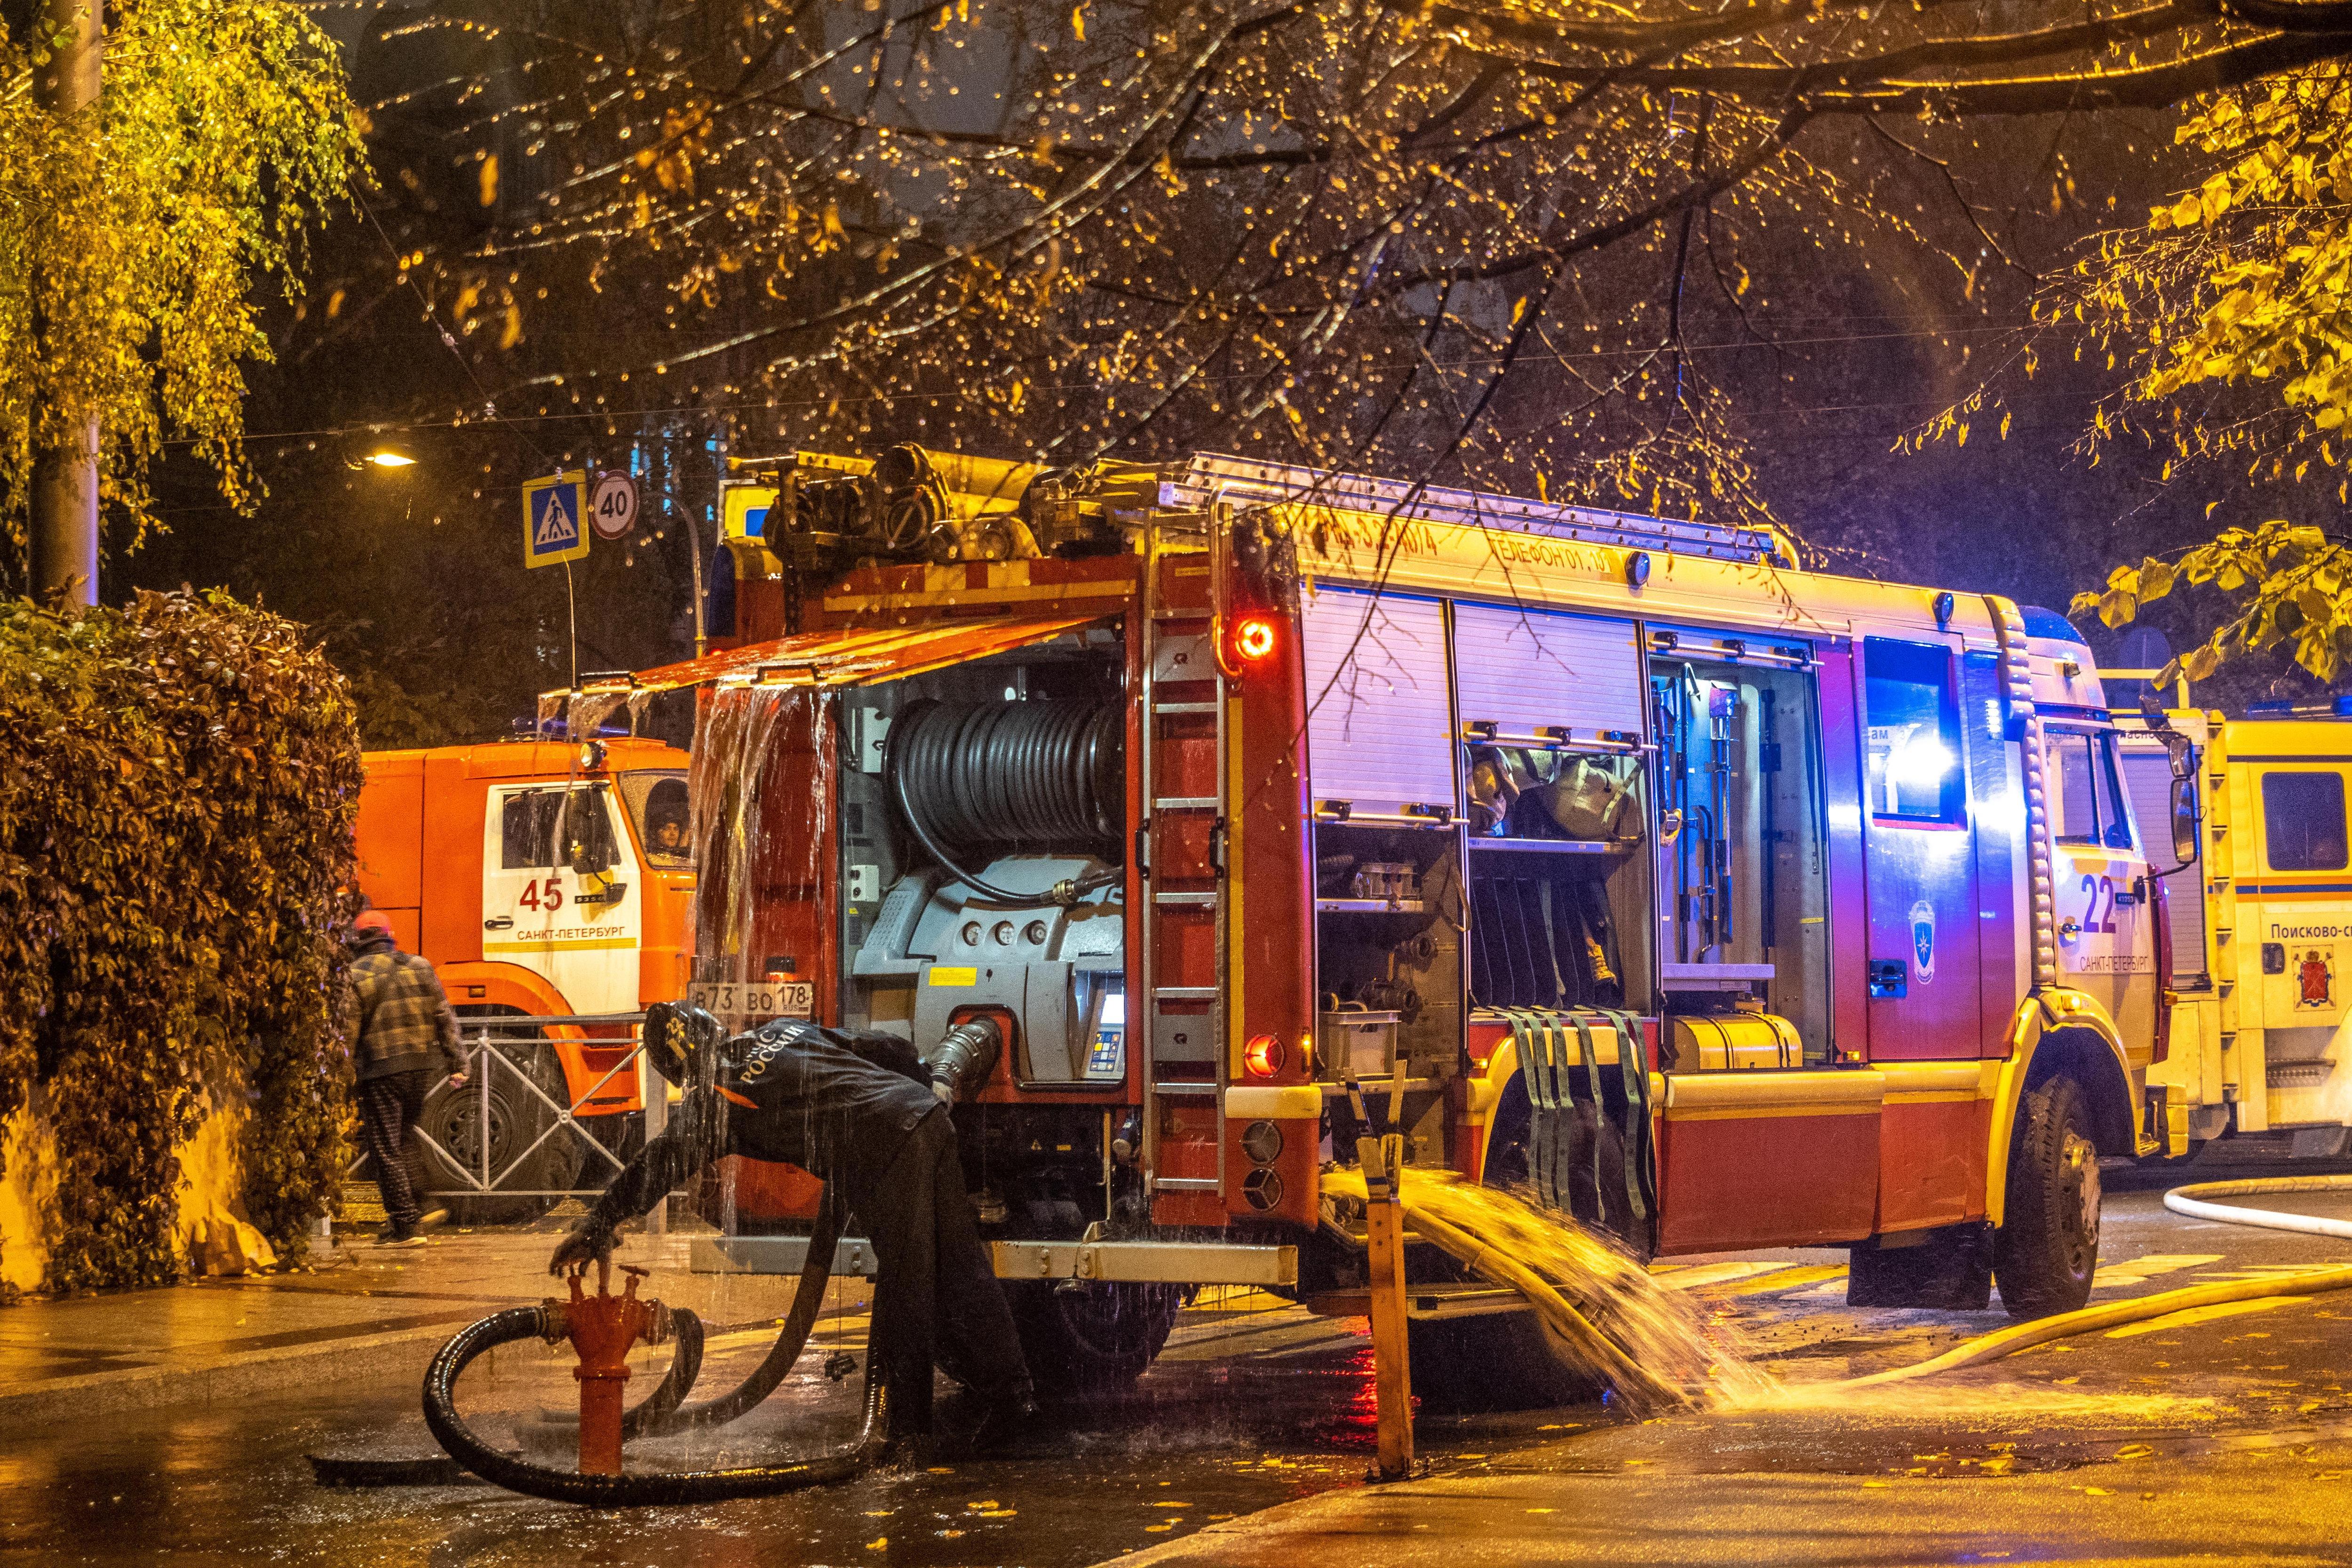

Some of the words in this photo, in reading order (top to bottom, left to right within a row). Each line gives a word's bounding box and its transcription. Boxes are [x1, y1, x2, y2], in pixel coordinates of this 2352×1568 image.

[600, 490, 628, 518] 40
[1489, 539, 1565, 568] ТЕЛЕФОН
[519, 878, 563, 912] 45
[2081, 874, 2116, 933] 22
[517, 926, 625, 940] САНКТ-ПЕТЕРБУРГ
[2080, 956, 2148, 971] САНКТ-ПЕТЕРБУРГ
[777, 986, 806, 1004] 178
[740, 1026, 805, 1084] РОССИИ
